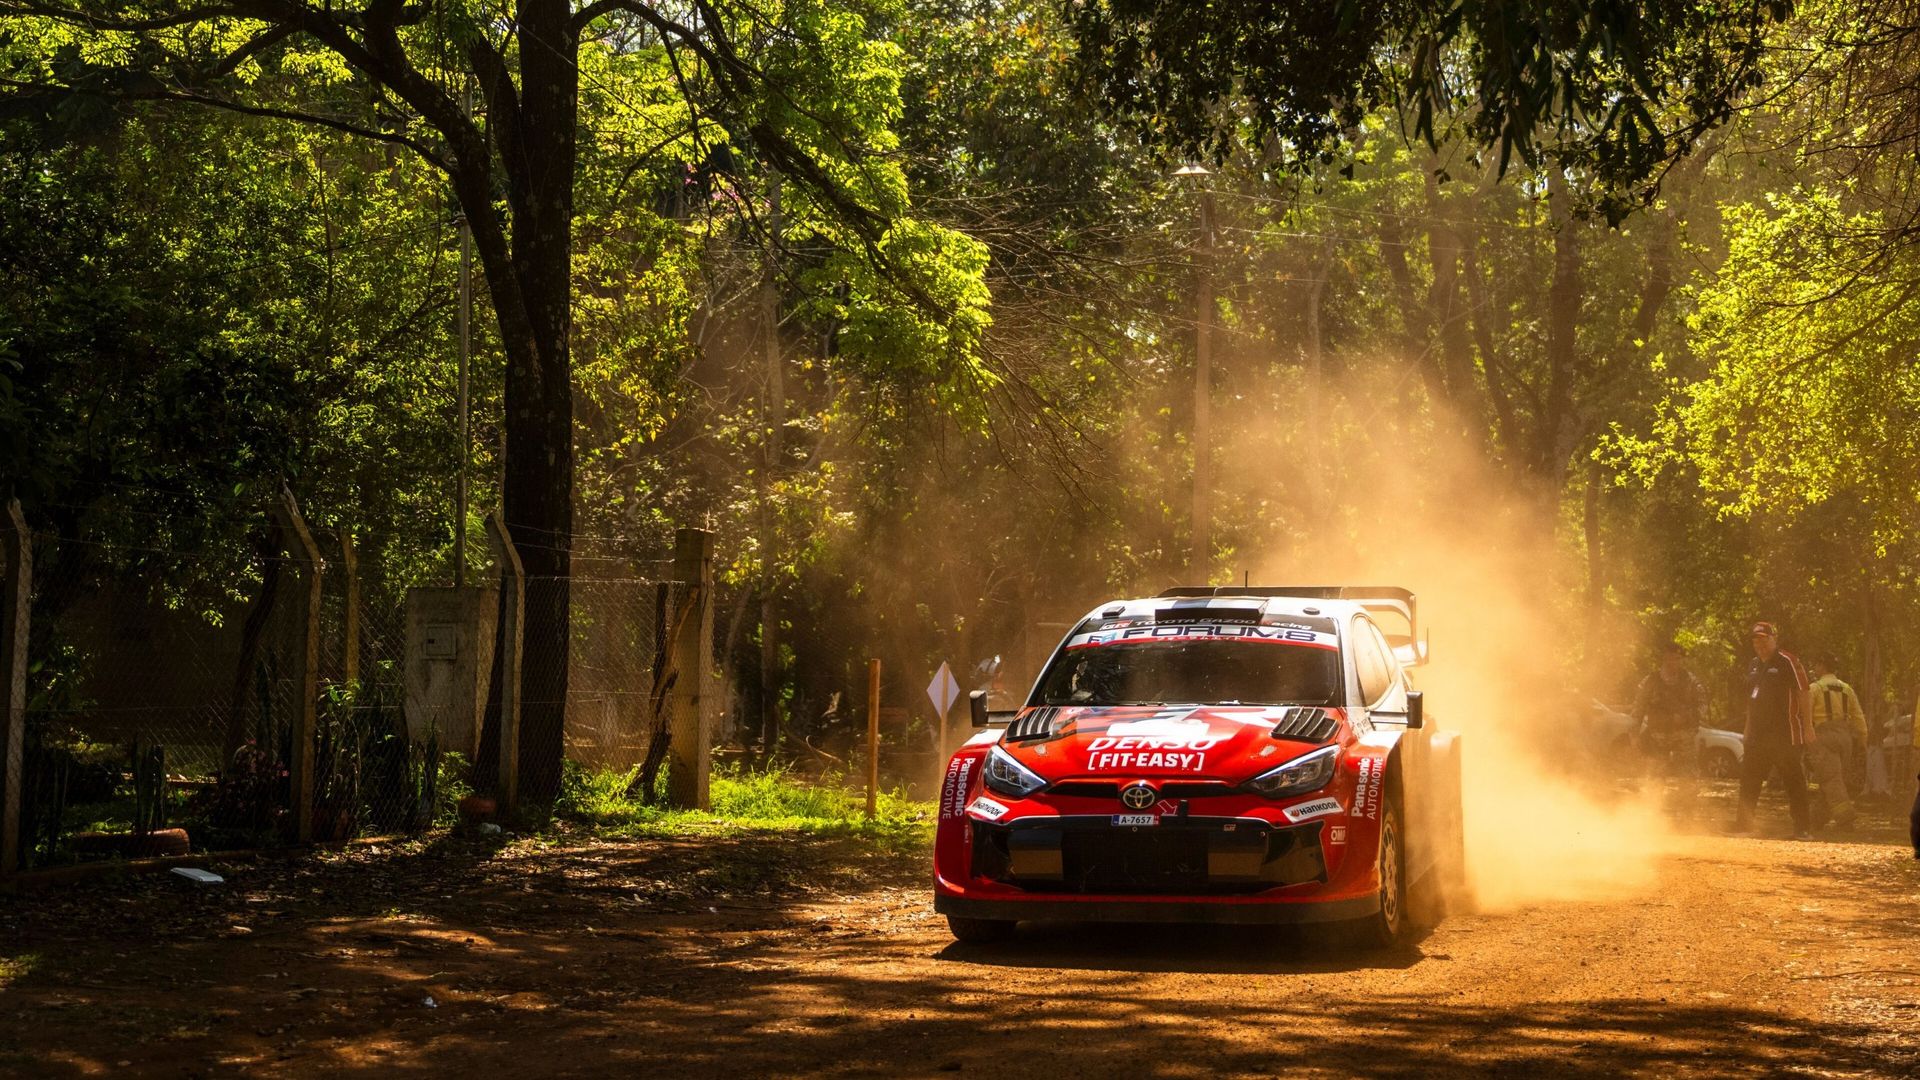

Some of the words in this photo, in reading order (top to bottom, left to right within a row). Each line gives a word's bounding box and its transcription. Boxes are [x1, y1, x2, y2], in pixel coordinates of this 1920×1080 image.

[1123, 626, 1316, 642] FORUM8
[1086, 736, 1217, 751] DENSO
[942, 757, 961, 819] AUTOMOTIVE
[954, 757, 976, 817] Panasonic
[1351, 757, 1370, 817] Panasonic
[1366, 756, 1384, 820] AUTOMOTIVE
[1121, 816, 1152, 825] A-7657
